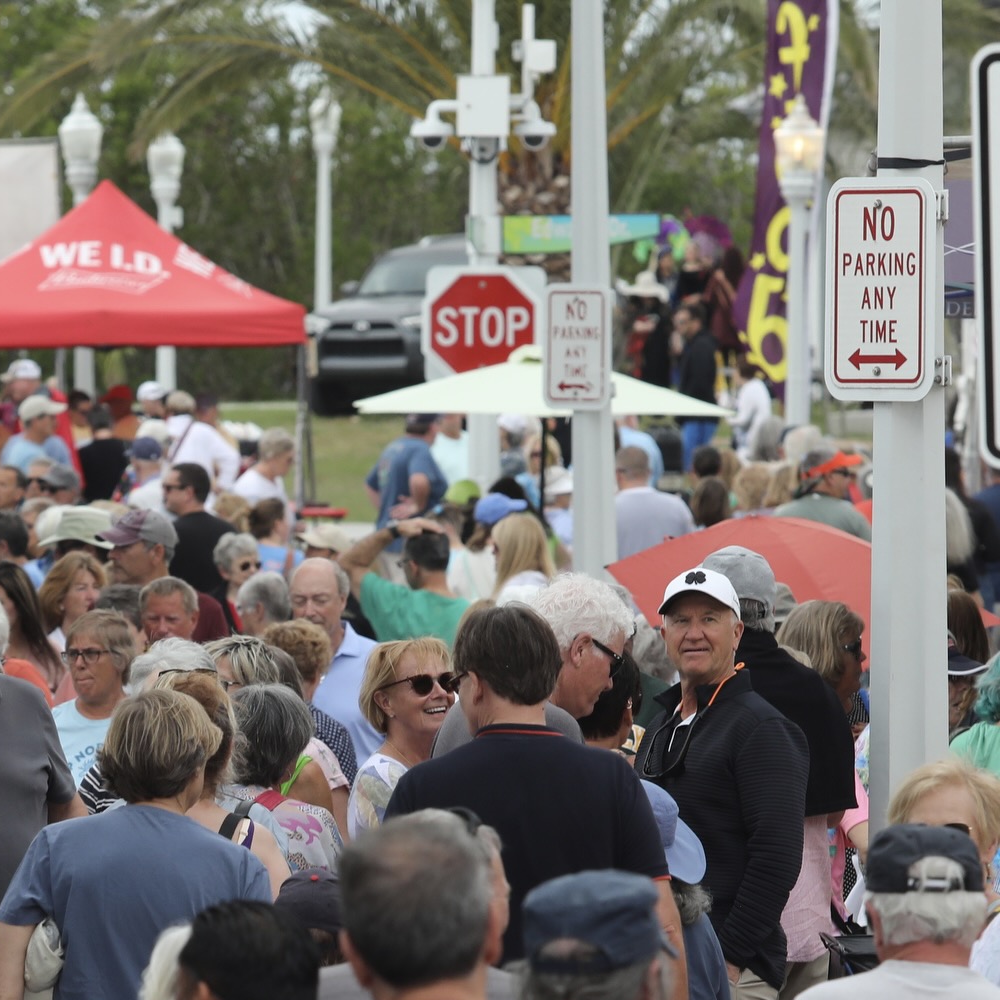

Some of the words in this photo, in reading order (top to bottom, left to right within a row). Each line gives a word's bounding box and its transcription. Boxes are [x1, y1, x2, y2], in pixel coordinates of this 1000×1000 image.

[863, 206, 895, 242] NO
[39, 240, 102, 268] WE
[842, 252, 916, 277] PARKING
[861, 286, 897, 310] ANY
[565, 302, 587, 320] NO
[435, 306, 530, 347] STOP
[552, 326, 601, 340] PARKING
[860, 319, 898, 344] TIME
[565, 346, 586, 359] ANY
[564, 364, 586, 378] TIME
